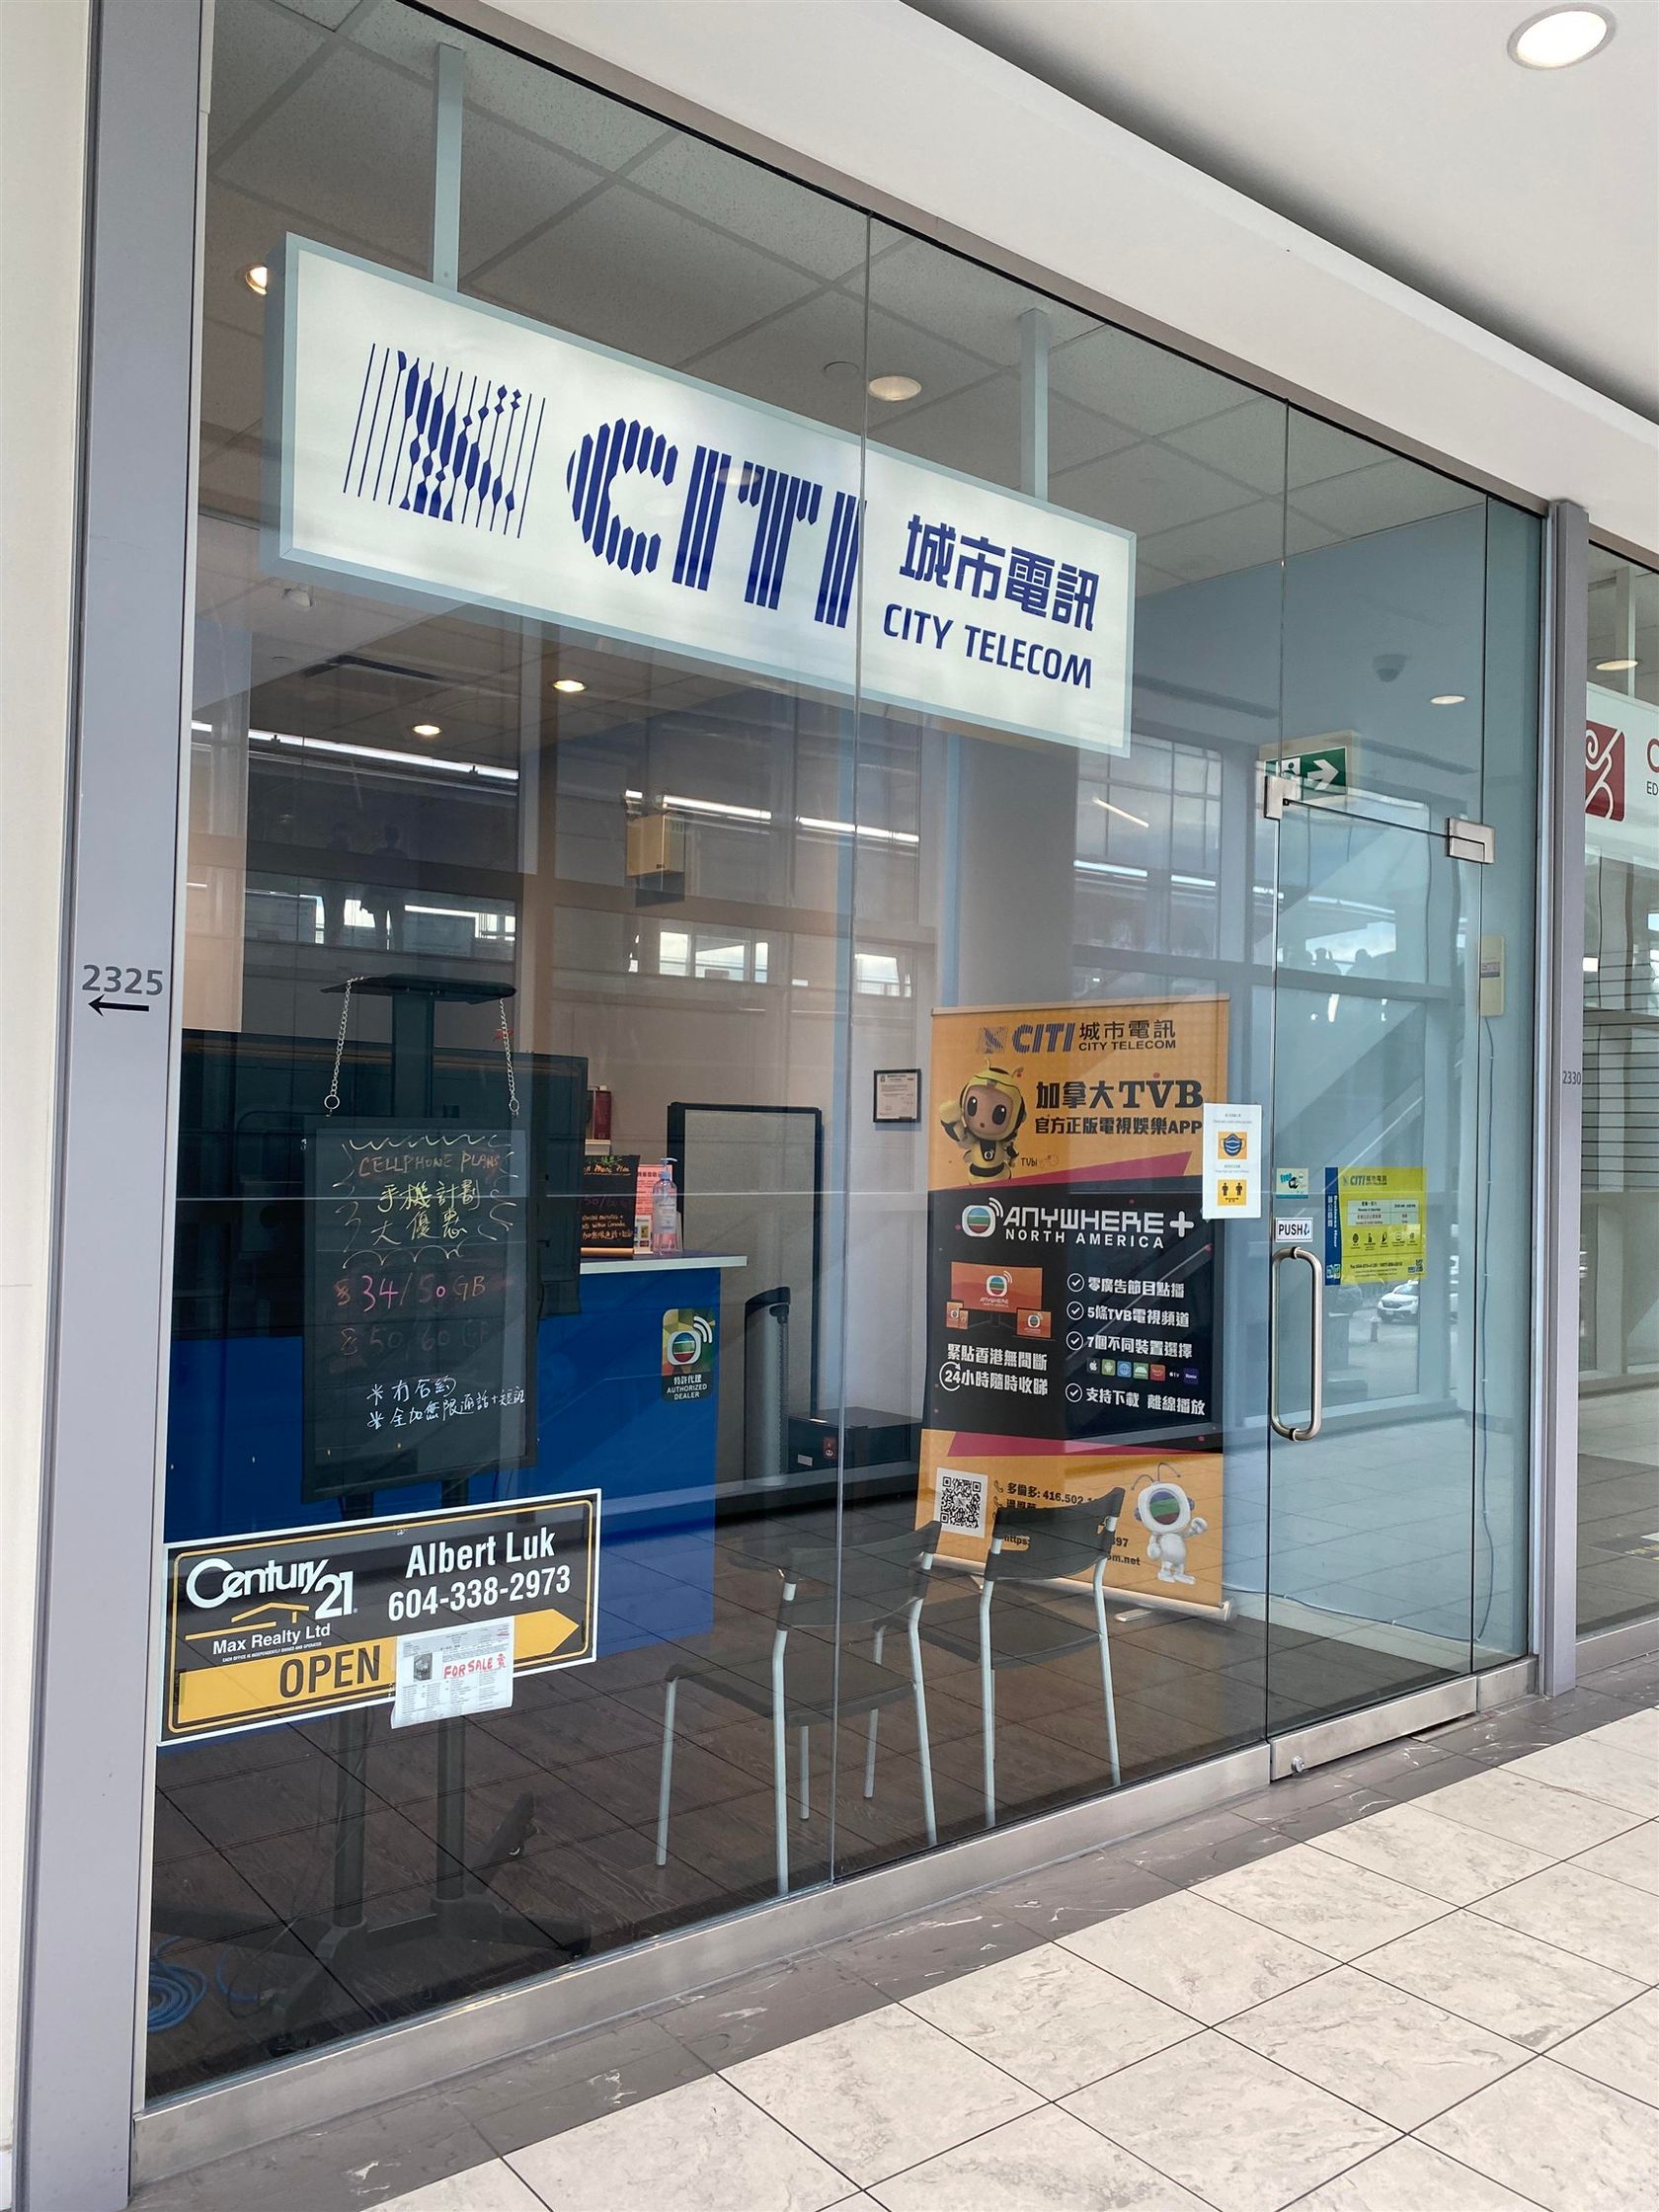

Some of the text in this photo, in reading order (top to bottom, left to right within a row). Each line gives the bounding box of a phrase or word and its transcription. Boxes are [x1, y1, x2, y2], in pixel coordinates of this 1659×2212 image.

[566, 417, 866, 629] CITI
[899, 514, 1100, 632] 城市電訊
[883, 602, 1092, 689] CITY TELECOM
[82, 965, 163, 995] 2325
[1012, 1023, 1075, 1054] CITI
[1078, 1019, 1175, 1042] 城市電訊
[1078, 1040, 1176, 1052] CITY TELECOM
[1562, 1070, 1581, 1085] 2330
[359, 1150, 501, 1177] CELLPHONE PLANS
[377, 1182, 481, 1213] 手機計劃
[1003, 1206, 1163, 1233] ANYWHERE
[1279, 1224, 1303, 1235] PUSH
[1005, 1228, 1163, 1249] NORTH AMERICA
[1087, 1276, 1185, 1299] 零廣告節目點播
[947, 1343, 1048, 1371] 緊貼香港無間斷
[1087, 1335, 1193, 1359] 7個不同裝置選擇
[667, 1383, 708, 1393] AUTHORIZED
[673, 1391, 700, 1400] DEALER
[1086, 1386, 1207, 1416] 支持下載 離線播放
[406, 1526, 556, 1578] Albert Luk
[187, 1557, 329, 1610] Century
[314, 1570, 354, 1620] 21
[388, 1564, 571, 1621] 604-338-2973
[212, 1622, 331, 1655] Max Realty Ltd
[252, 1648, 281, 1658] INDEPENDENTLY
[279, 1644, 380, 1698] OPEN
[443, 1664, 466, 1679] FOR
[468, 1657, 494, 1672] SALE
